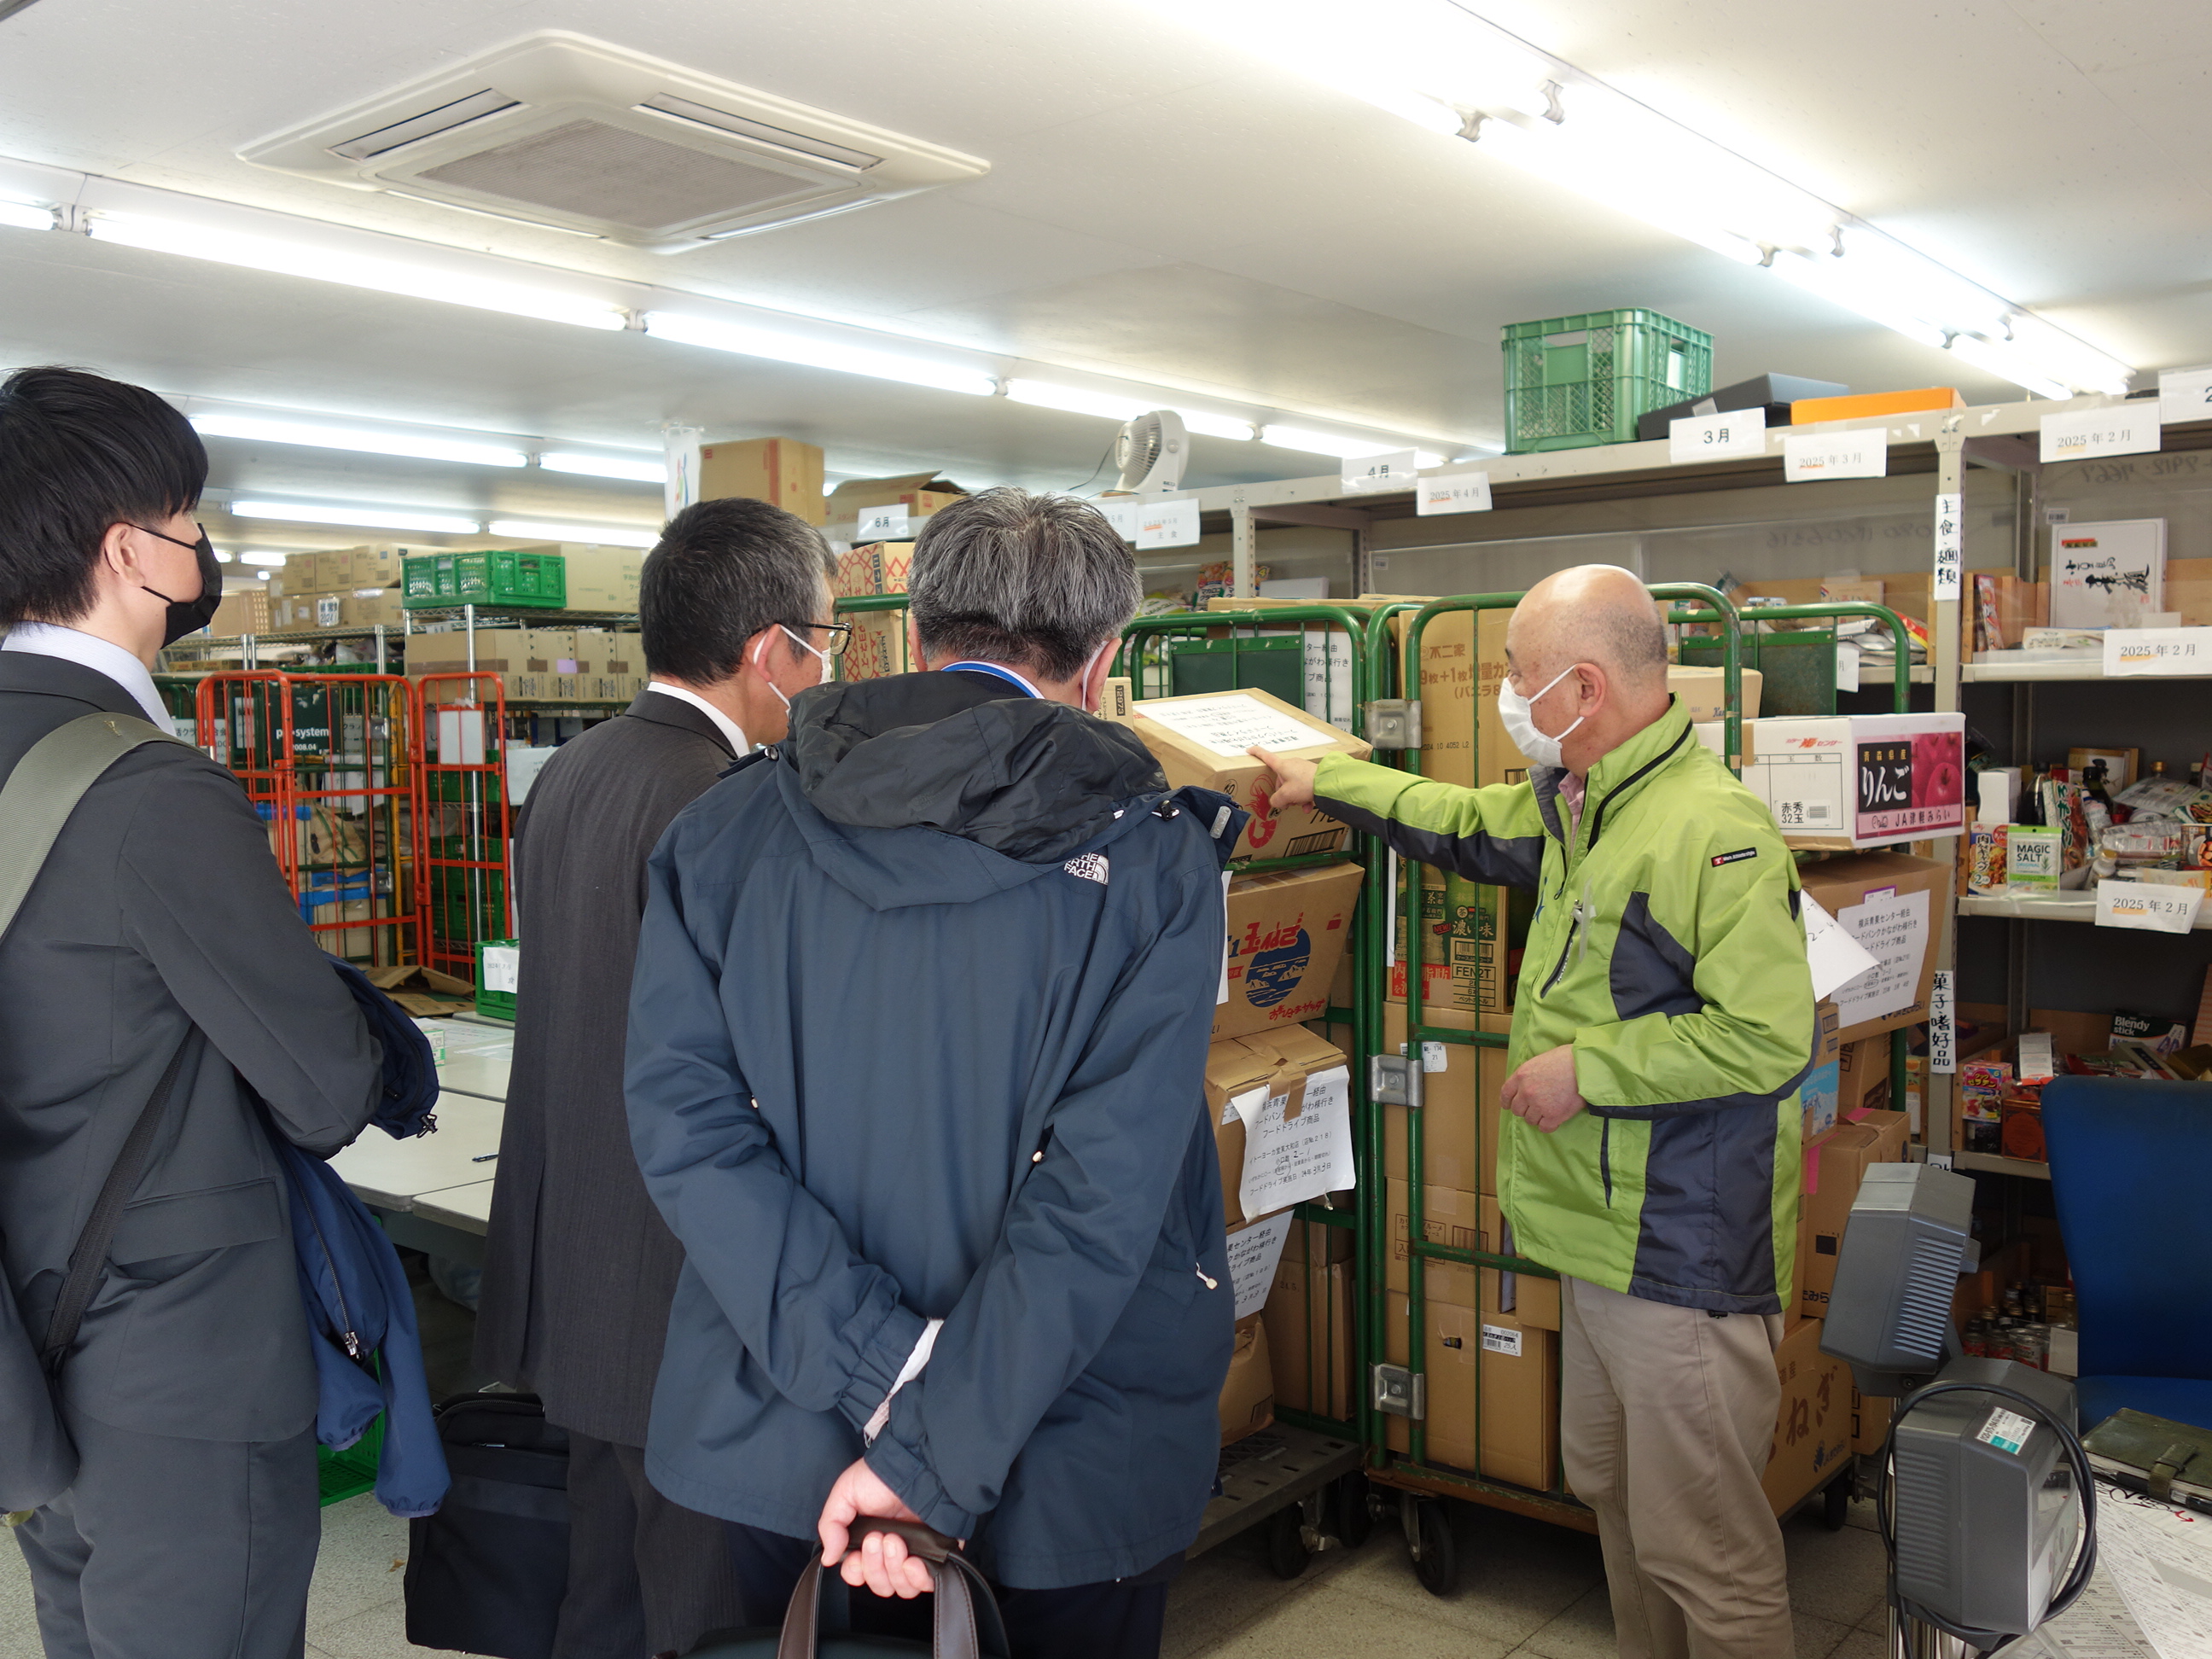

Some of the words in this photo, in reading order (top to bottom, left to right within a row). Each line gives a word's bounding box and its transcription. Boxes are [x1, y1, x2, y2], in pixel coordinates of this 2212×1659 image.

[1703, 428, 1730, 444] 3月
[1367, 464, 1389, 478] 4月
[875, 516, 889, 527] 6月
[1429, 643, 1466, 660] 不二家
[1116, 686, 1125, 714] 12973
[1864, 748, 1907, 762] 青森県産
[1861, 765, 1910, 808] りんご
[1781, 801, 1804, 812] 赤秀
[1781, 812, 1804, 824] 32玉
[2017, 844, 2051, 854] MAGIC
[2017, 853, 2042, 863] SALT
[1063, 862, 1094, 880] FACE
[2114, 1015, 2150, 1033] Blendy
[2114, 1025, 2135, 1036] stick
